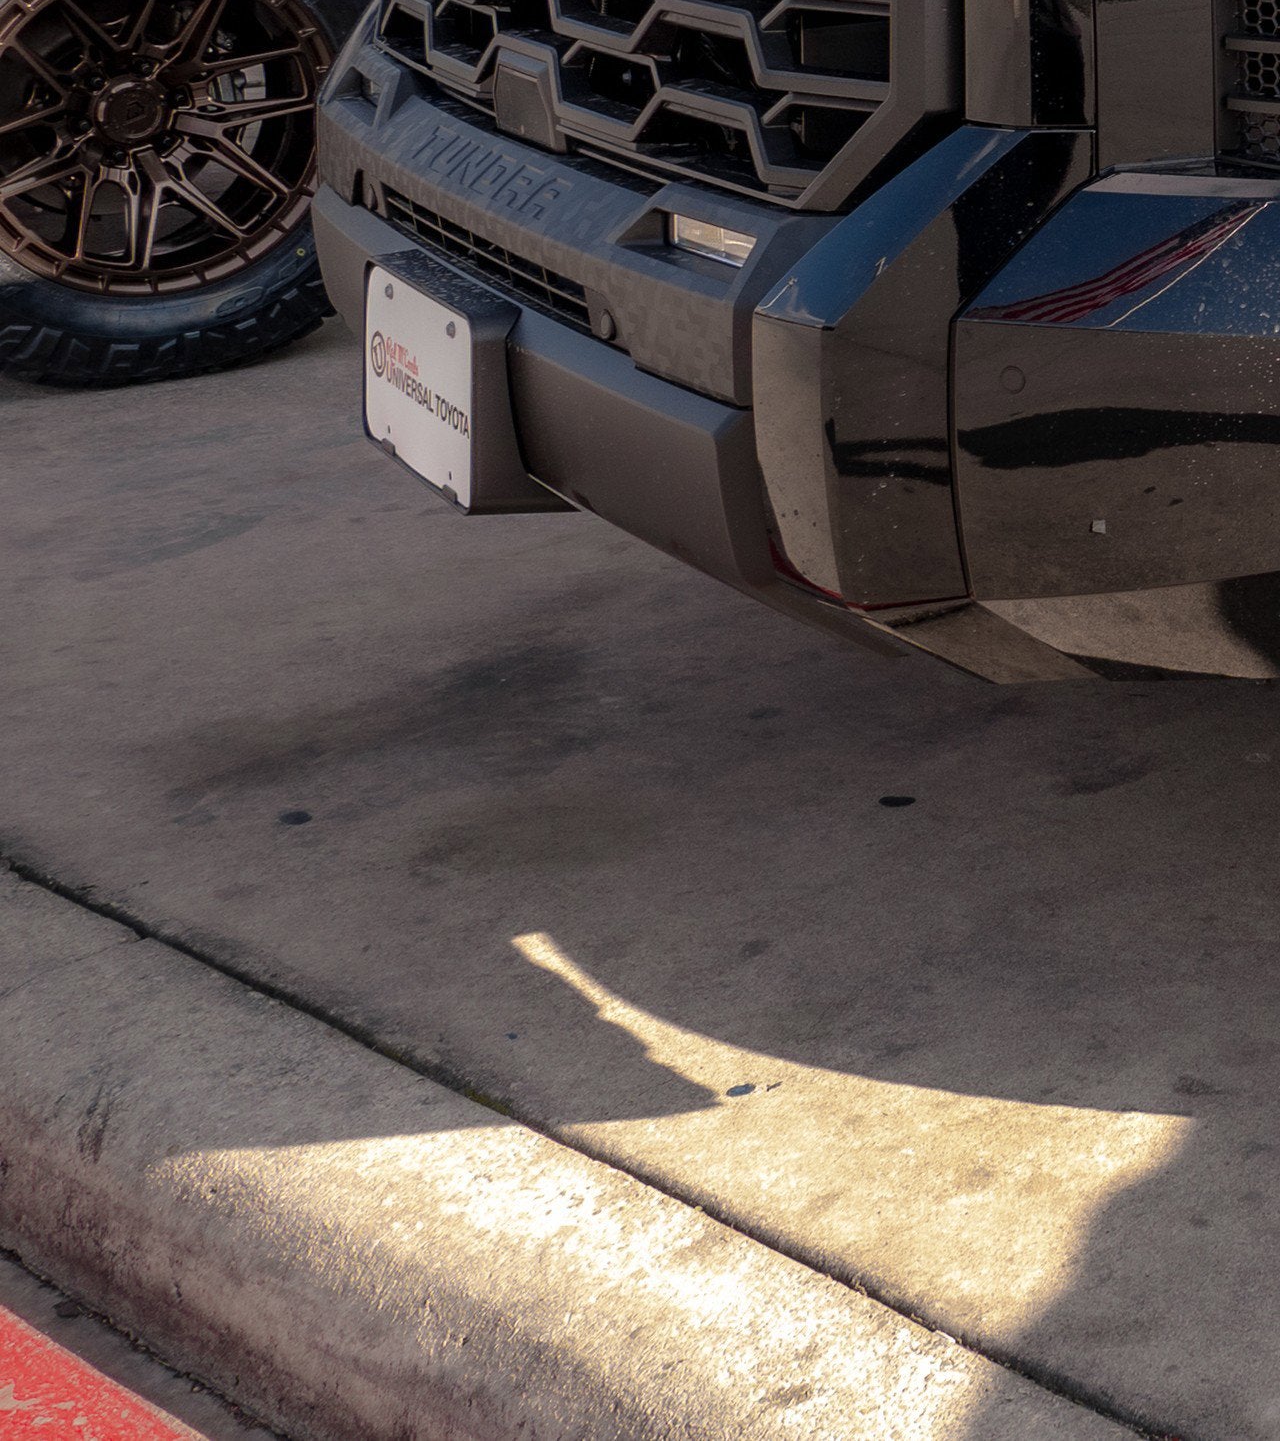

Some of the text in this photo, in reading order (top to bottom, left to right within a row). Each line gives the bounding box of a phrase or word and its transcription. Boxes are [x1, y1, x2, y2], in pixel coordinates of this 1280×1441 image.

[411, 124, 573, 220] TUNDRA
[386, 359, 470, 439] UNIVERSAL TOYOTA
